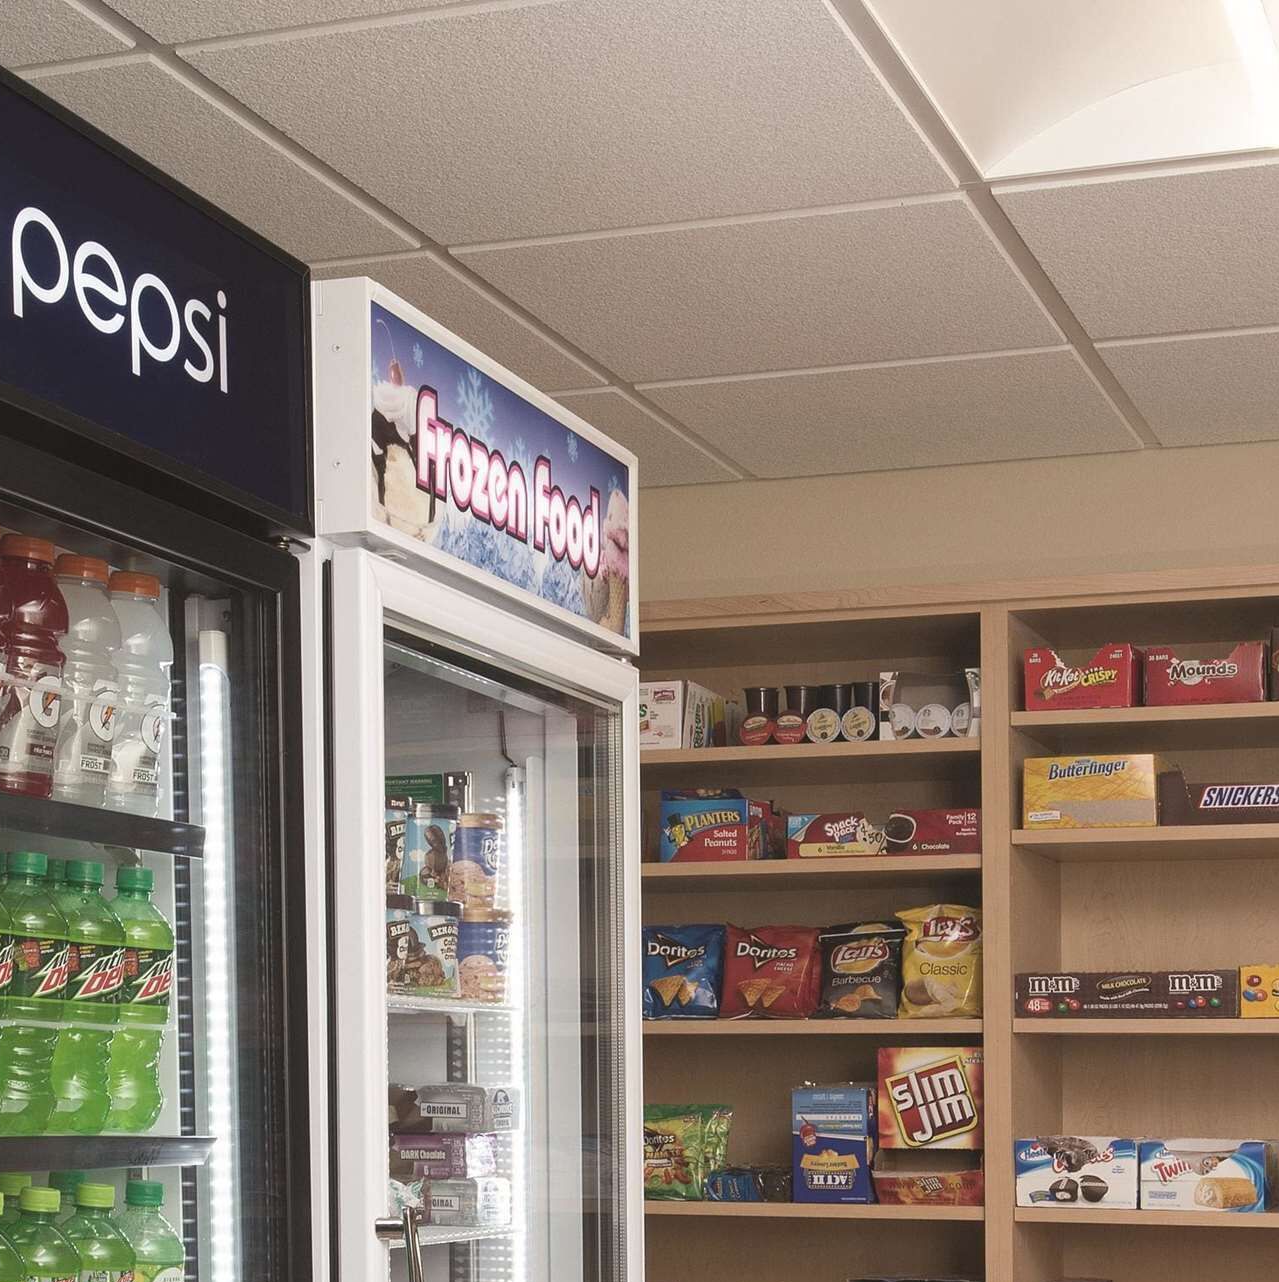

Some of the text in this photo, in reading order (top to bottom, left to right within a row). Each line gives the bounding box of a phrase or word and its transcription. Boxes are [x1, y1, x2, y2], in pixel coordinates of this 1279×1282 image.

[11, 206, 230, 394] pepsi
[1081, 668, 1119, 687] CRISPY
[1170, 662, 1239, 679] Mounds
[80, 758, 103, 770] FROST
[1047, 758, 1129, 782] Butterfinger
[133, 771, 155, 782] FROST
[684, 810, 741, 831] PLANTERS
[824, 816, 860, 836] Snack
[713, 829, 738, 839] Salted
[704, 838, 738, 849] Peanuts
[647, 941, 706, 960] Doritos
[736, 941, 798, 960] Doritos
[833, 939, 889, 965] Lay's
[919, 961, 969, 977] Classic
[831, 974, 882, 987] Barbecue
[1027, 1000, 1041, 1012] 48
[426, 1105, 461, 1116] ORIGINAL
[401, 1150, 419, 1160] DARK
